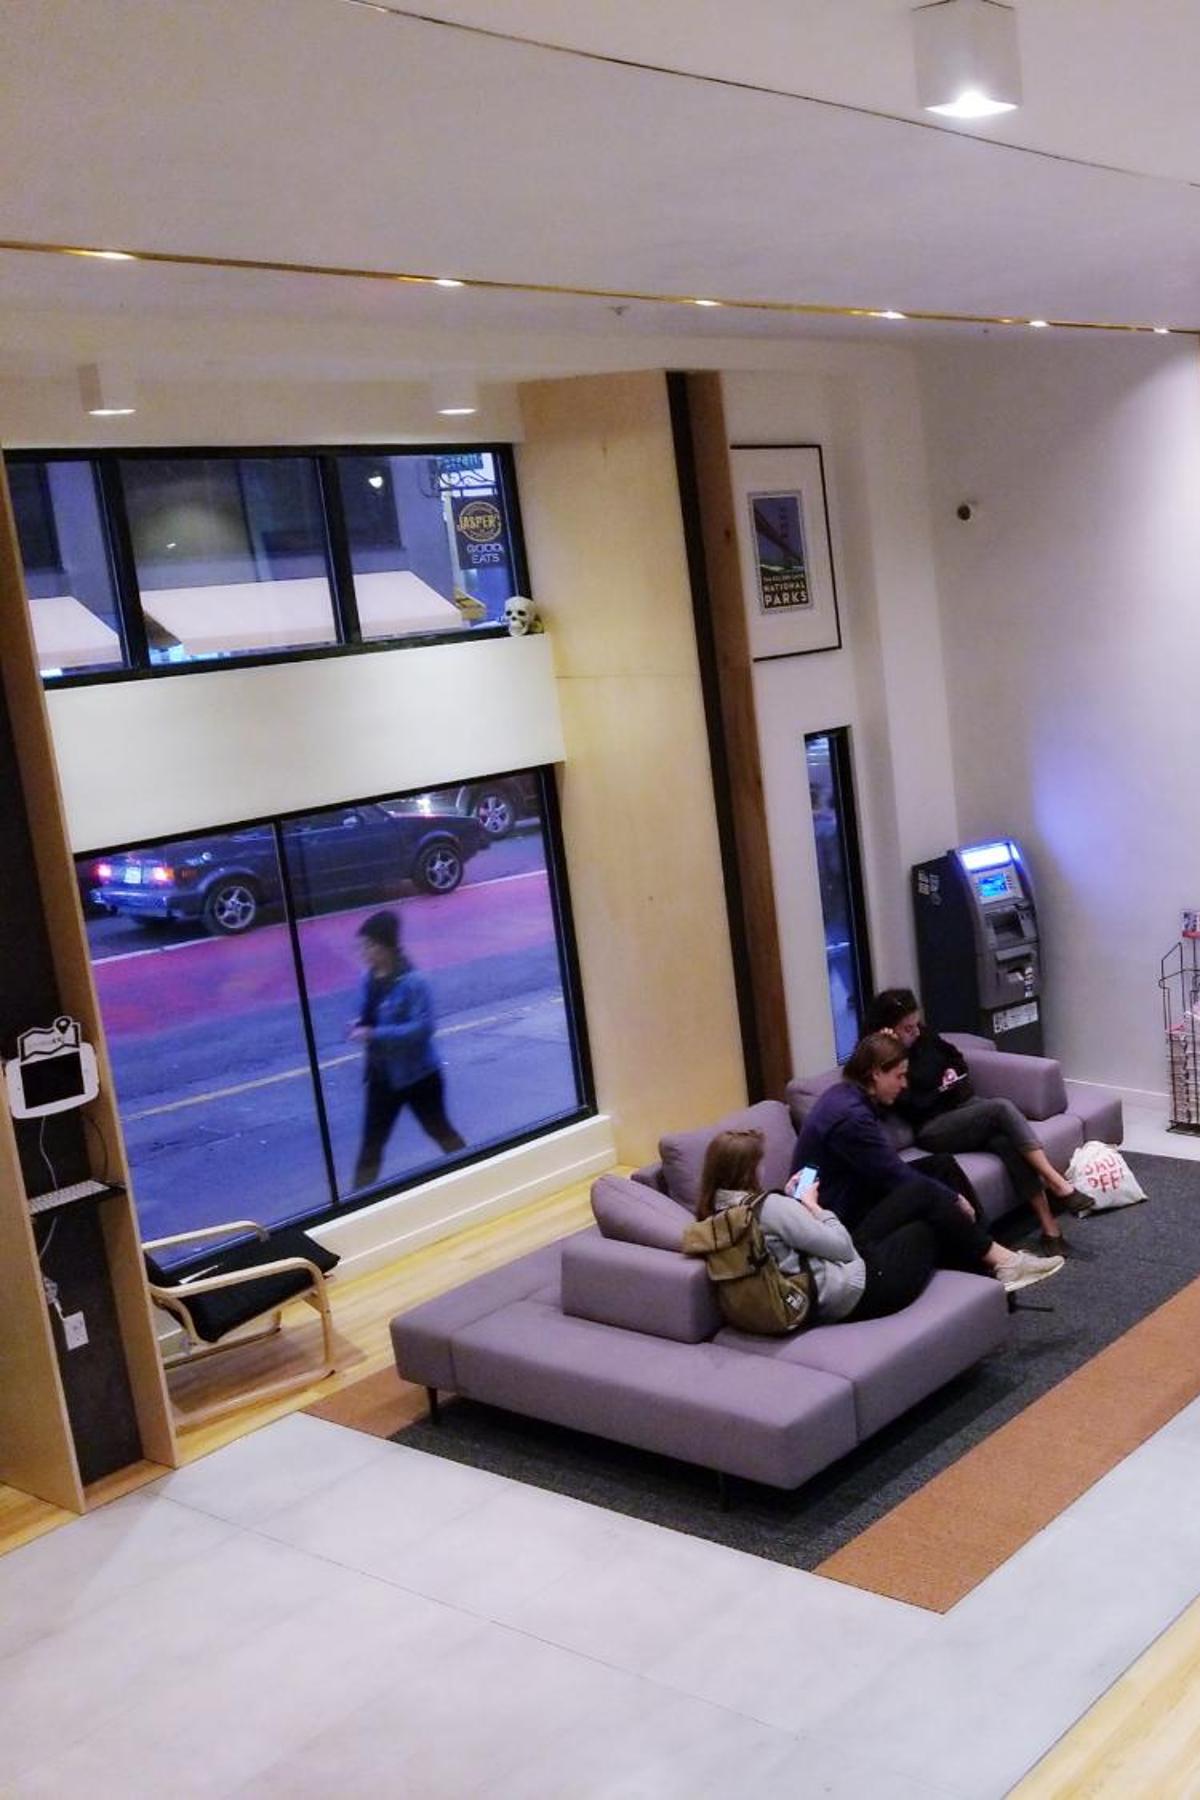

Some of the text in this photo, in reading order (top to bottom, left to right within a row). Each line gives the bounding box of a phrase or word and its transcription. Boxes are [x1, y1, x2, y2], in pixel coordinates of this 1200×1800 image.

[472, 553, 500, 564] EATS
[763, 581, 806, 592] NATIONAL
[764, 591, 807, 606] PARKS
